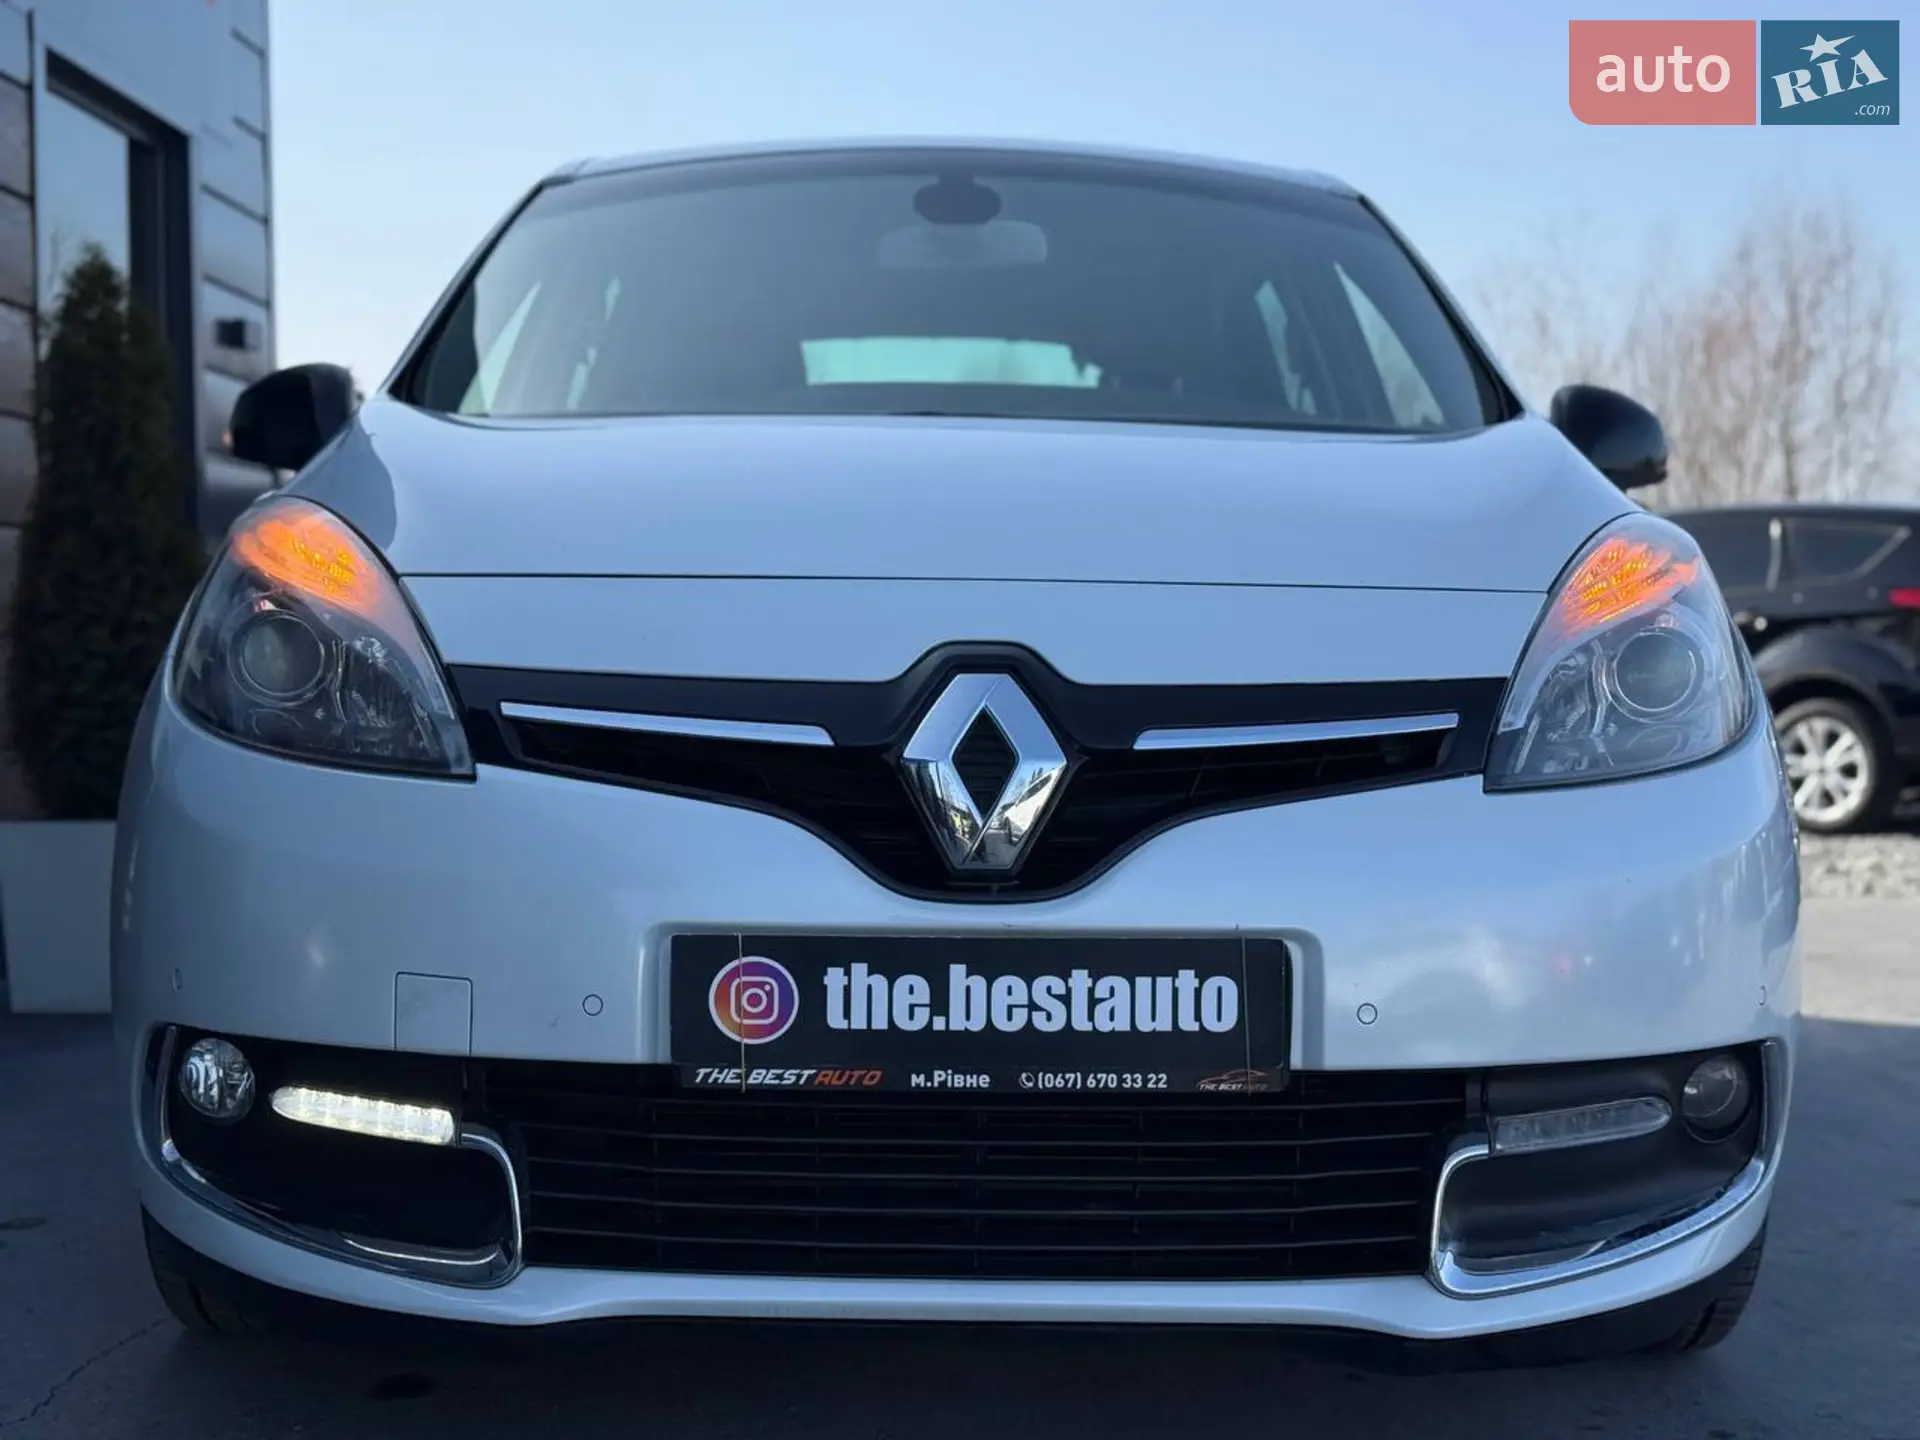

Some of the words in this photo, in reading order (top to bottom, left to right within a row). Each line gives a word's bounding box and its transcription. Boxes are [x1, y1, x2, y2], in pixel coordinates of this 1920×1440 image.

[824, 963, 1239, 1032] the.bestauto
[695, 1067, 743, 1084] THE
[1038, 1072, 1082, 1089] (067)
[1086, 1073, 1118, 1089] 670
[1121, 1073, 1143, 1089] 33
[1146, 1073, 1168, 1089] 22
